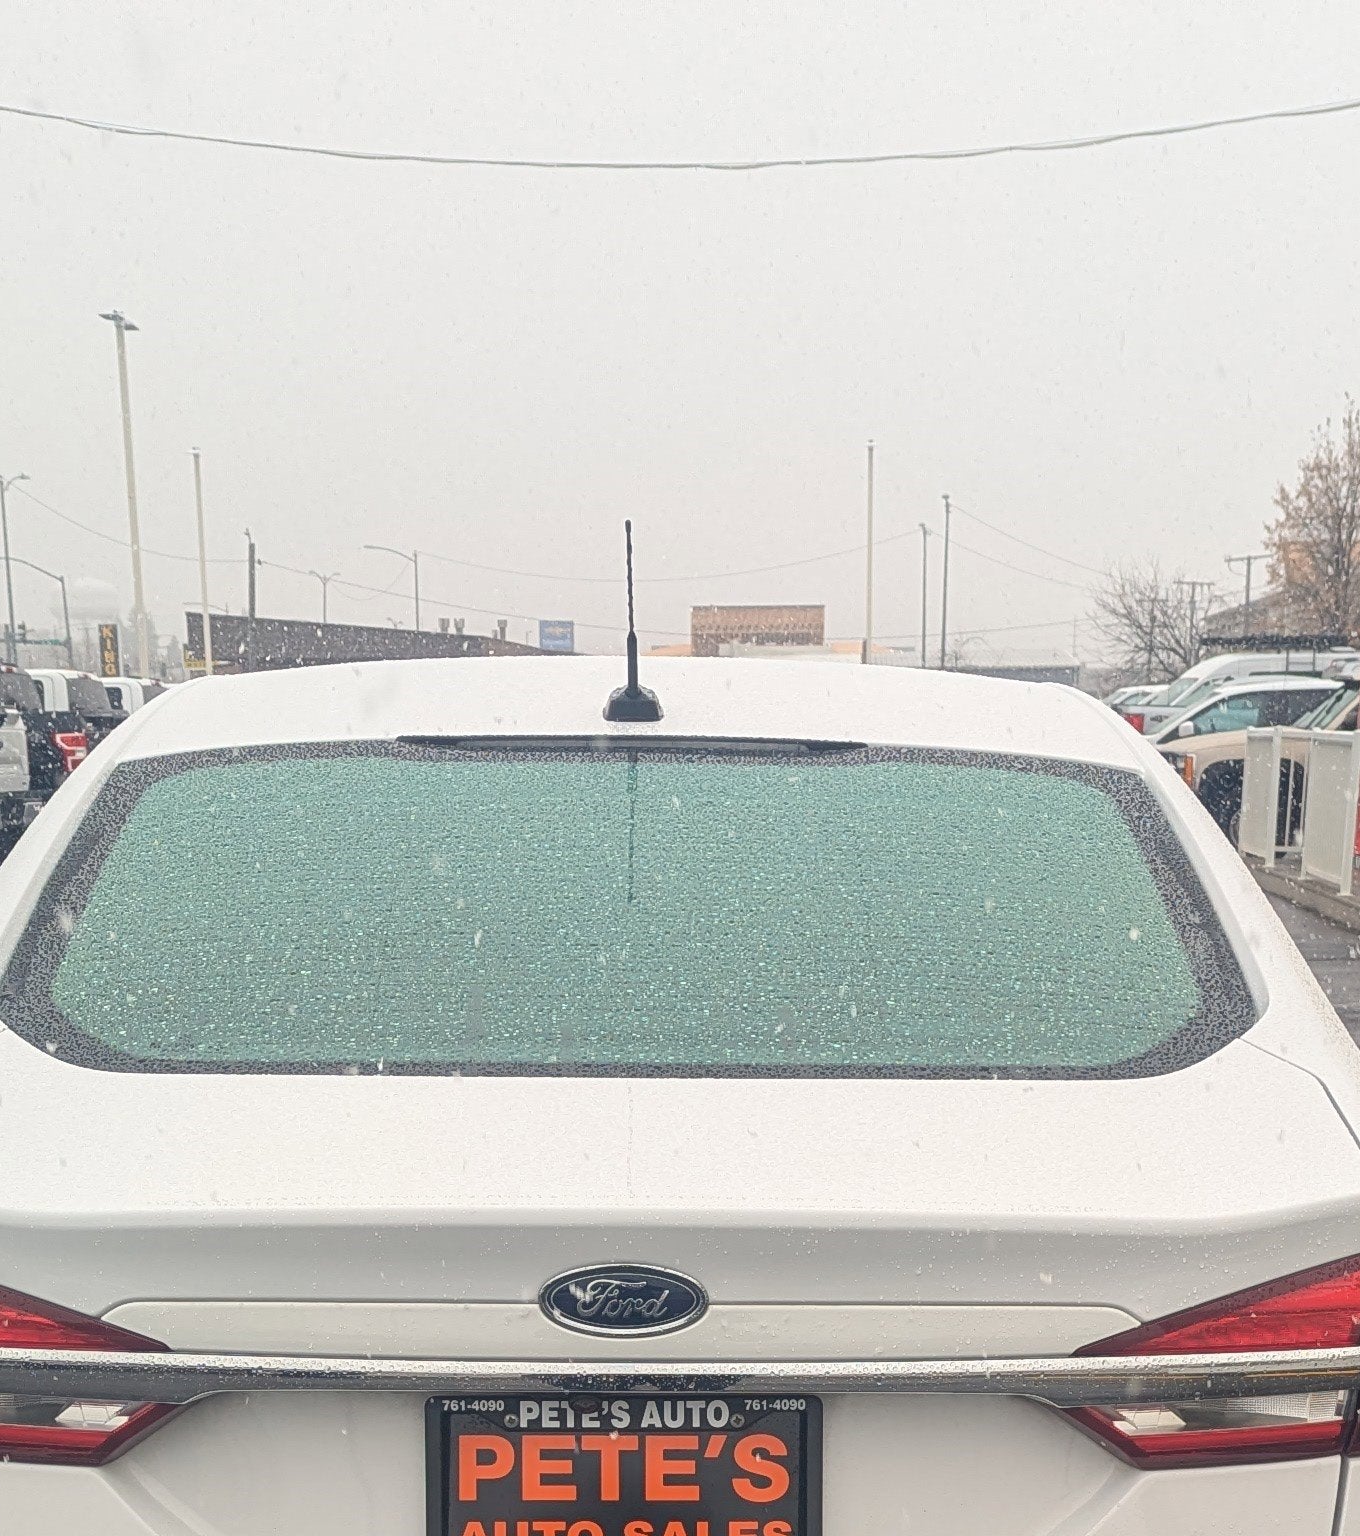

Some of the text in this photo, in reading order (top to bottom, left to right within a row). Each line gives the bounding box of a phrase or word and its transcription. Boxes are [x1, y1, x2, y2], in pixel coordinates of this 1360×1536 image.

[575, 1278, 669, 1319] Ford
[441, 1399, 505, 1413] 761-4090
[519, 1400, 730, 1429] PETE'S AUTO
[743, 1398, 807, 1412] 761-4090
[457, 1434, 790, 1504] PETE'S
